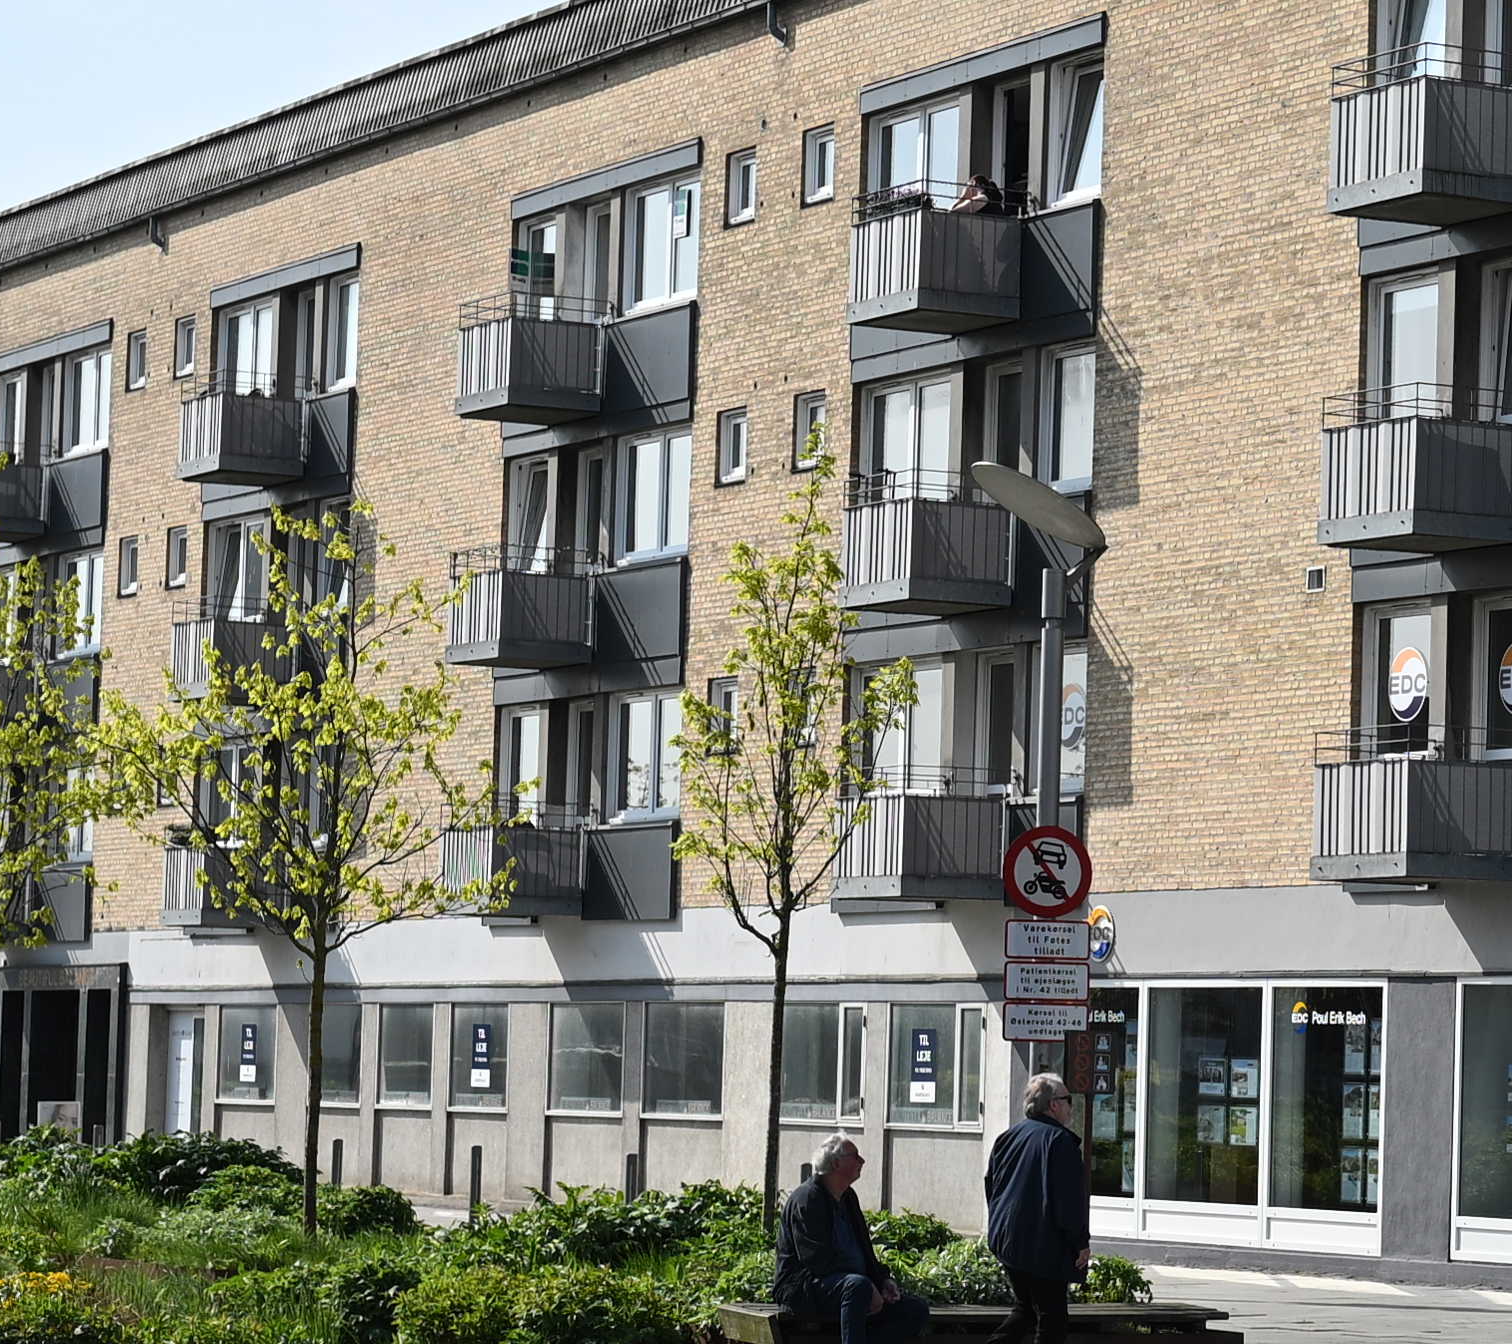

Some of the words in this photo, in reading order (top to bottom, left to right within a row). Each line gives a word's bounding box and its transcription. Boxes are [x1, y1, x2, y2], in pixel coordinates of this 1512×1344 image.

[1389, 673, 1426, 696] EDC
[1063, 706, 1085, 725] DC
[1023, 924, 1076, 933] Varekørsel
[1028, 936, 1039, 944] til
[1034, 947, 1065, 955] tilladt
[1108, 1010, 1125, 1023] Bech
[1291, 1013, 1309, 1024] EDC
[1311, 1010, 1327, 1024] Poul
[1329, 1010, 1345, 1024] Erik
[1346, 1011, 1366, 1024] Bech
[918, 1034, 929, 1046] TIL
[916, 1050, 932, 1062] LEJE
